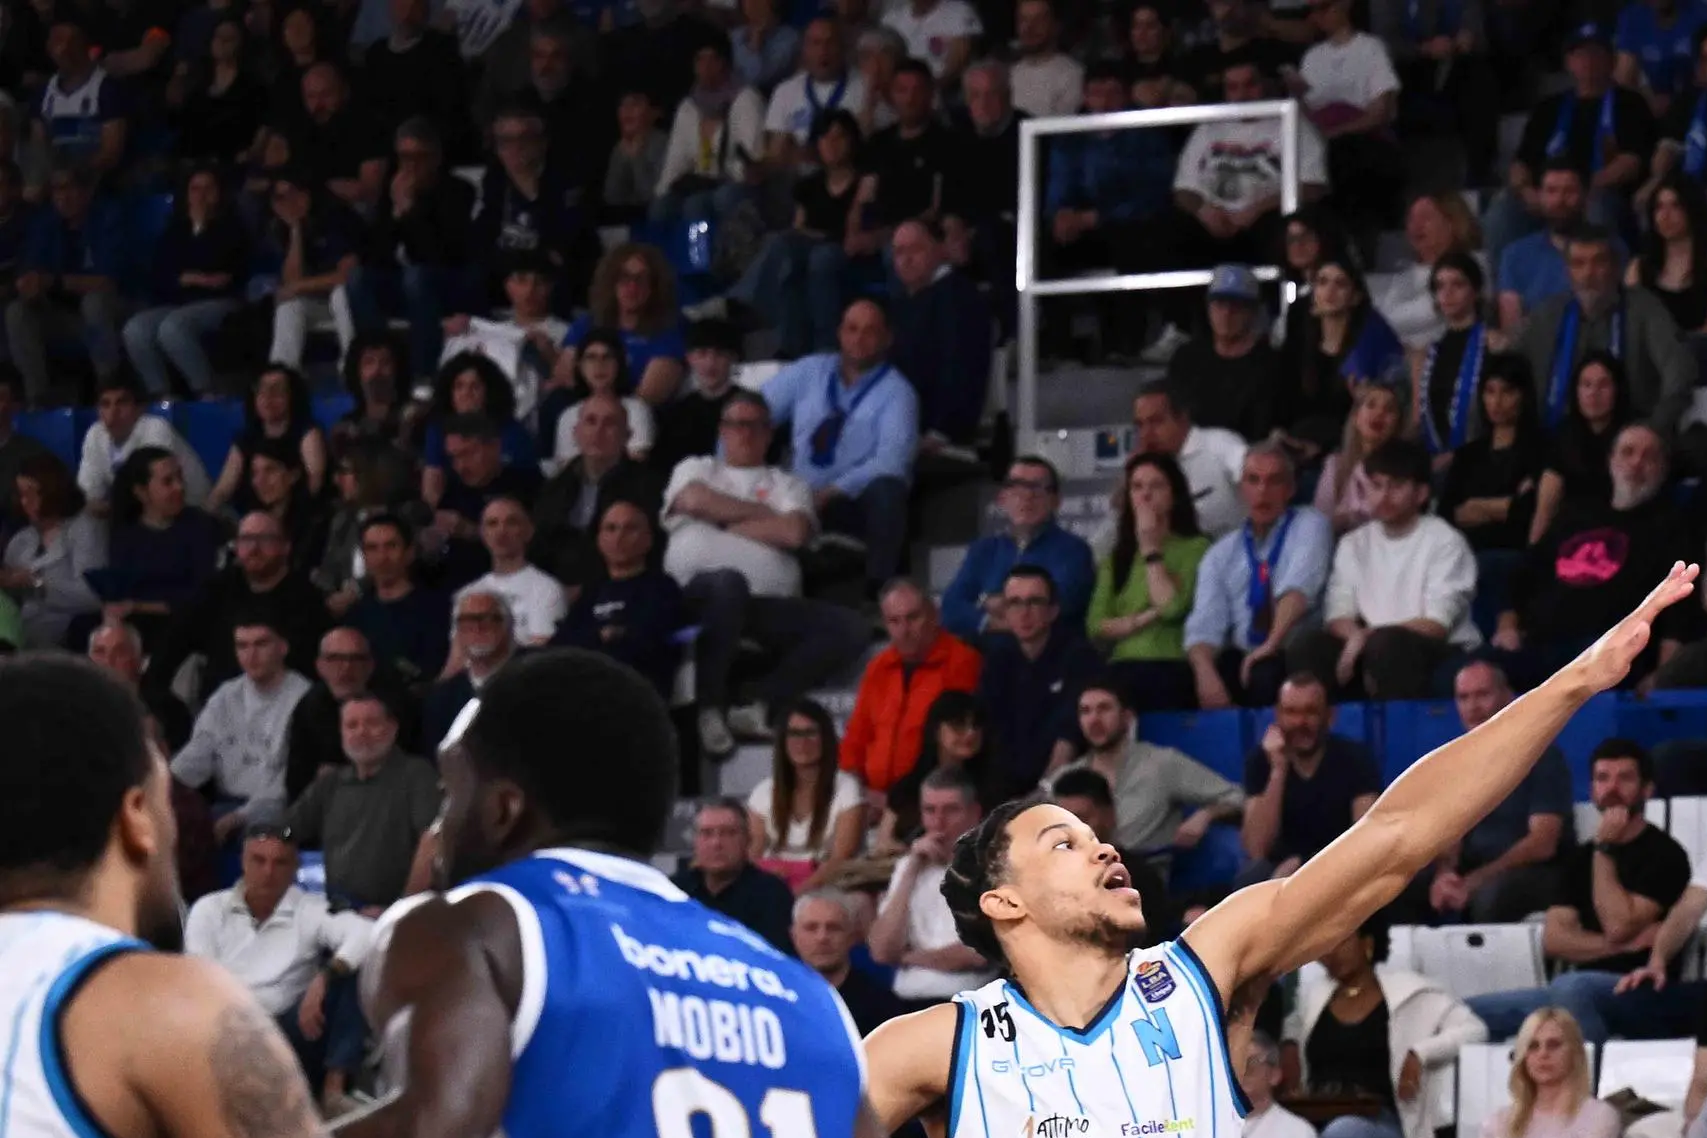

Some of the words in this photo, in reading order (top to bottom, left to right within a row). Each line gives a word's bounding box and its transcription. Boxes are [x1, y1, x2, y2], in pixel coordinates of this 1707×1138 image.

[647, 986, 787, 1070] MOBIO
[1131, 1007, 1182, 1067] N
[992, 1057, 1076, 1078] GOVA
[1037, 1112, 1090, 1138] ATTIMO
